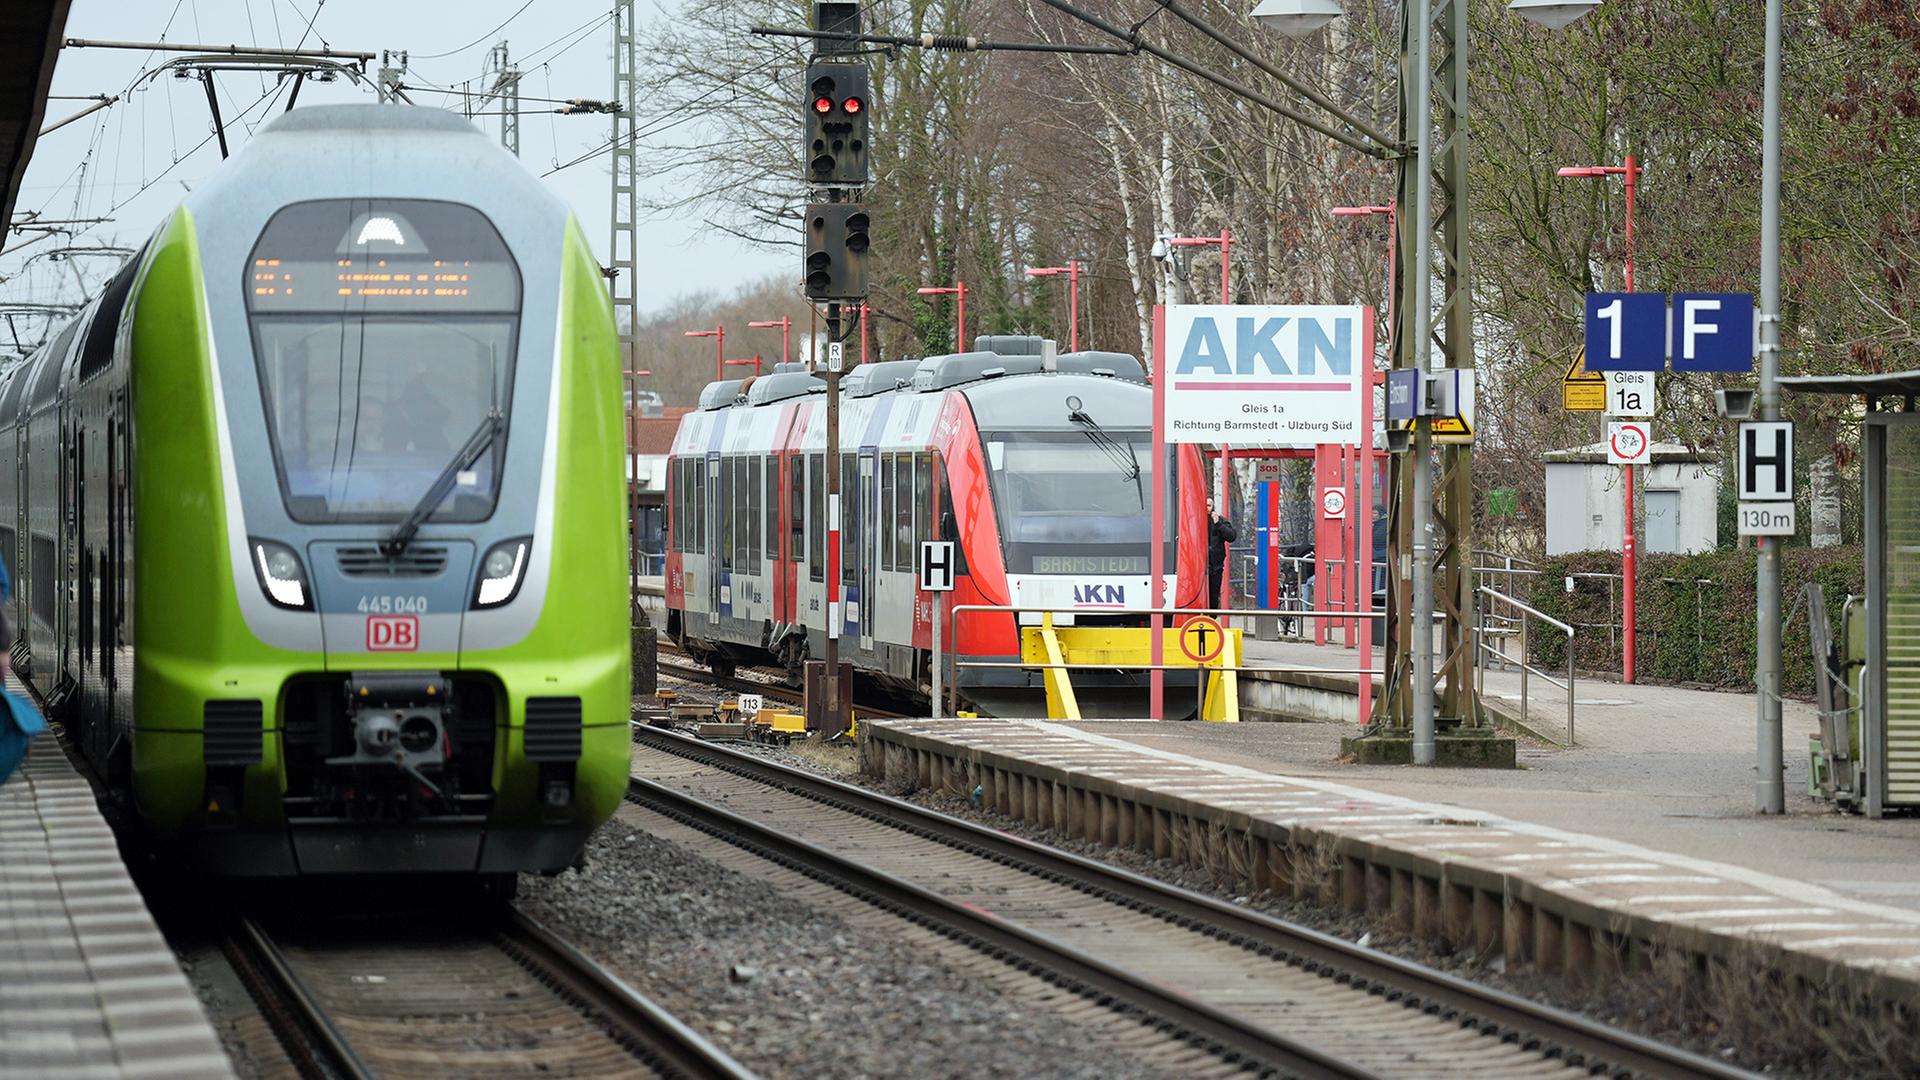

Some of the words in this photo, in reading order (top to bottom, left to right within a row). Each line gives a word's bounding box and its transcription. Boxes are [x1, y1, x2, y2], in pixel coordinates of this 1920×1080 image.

[1597, 299, 1622, 359] 1
[1683, 300, 1721, 359] F
[831, 344, 839, 356] R
[1175, 317, 1352, 376] AKN
[1614, 371, 1645, 384] Gleis
[1616, 388, 1642, 410] 1a
[1241, 403, 1269, 414] Gleis
[1272, 403, 1285, 414] 1a
[1173, 420, 1221, 432] Richtung
[1224, 420, 1278, 430] Barmstedt
[1288, 420, 1328, 432] Ulzburg
[1331, 419, 1353, 431] Süd
[1259, 465, 1279, 473] SOS
[1745, 429, 1786, 493] H
[1743, 510, 1770, 528] 130
[1773, 514, 1790, 528] m
[924, 545, 951, 587] H
[1039, 557, 1138, 573] BARMSTEDT
[357, 595, 391, 613] 445
[394, 595, 428, 613] 040
[373, 622, 412, 645] DB
[742, 698, 758, 710] 113
